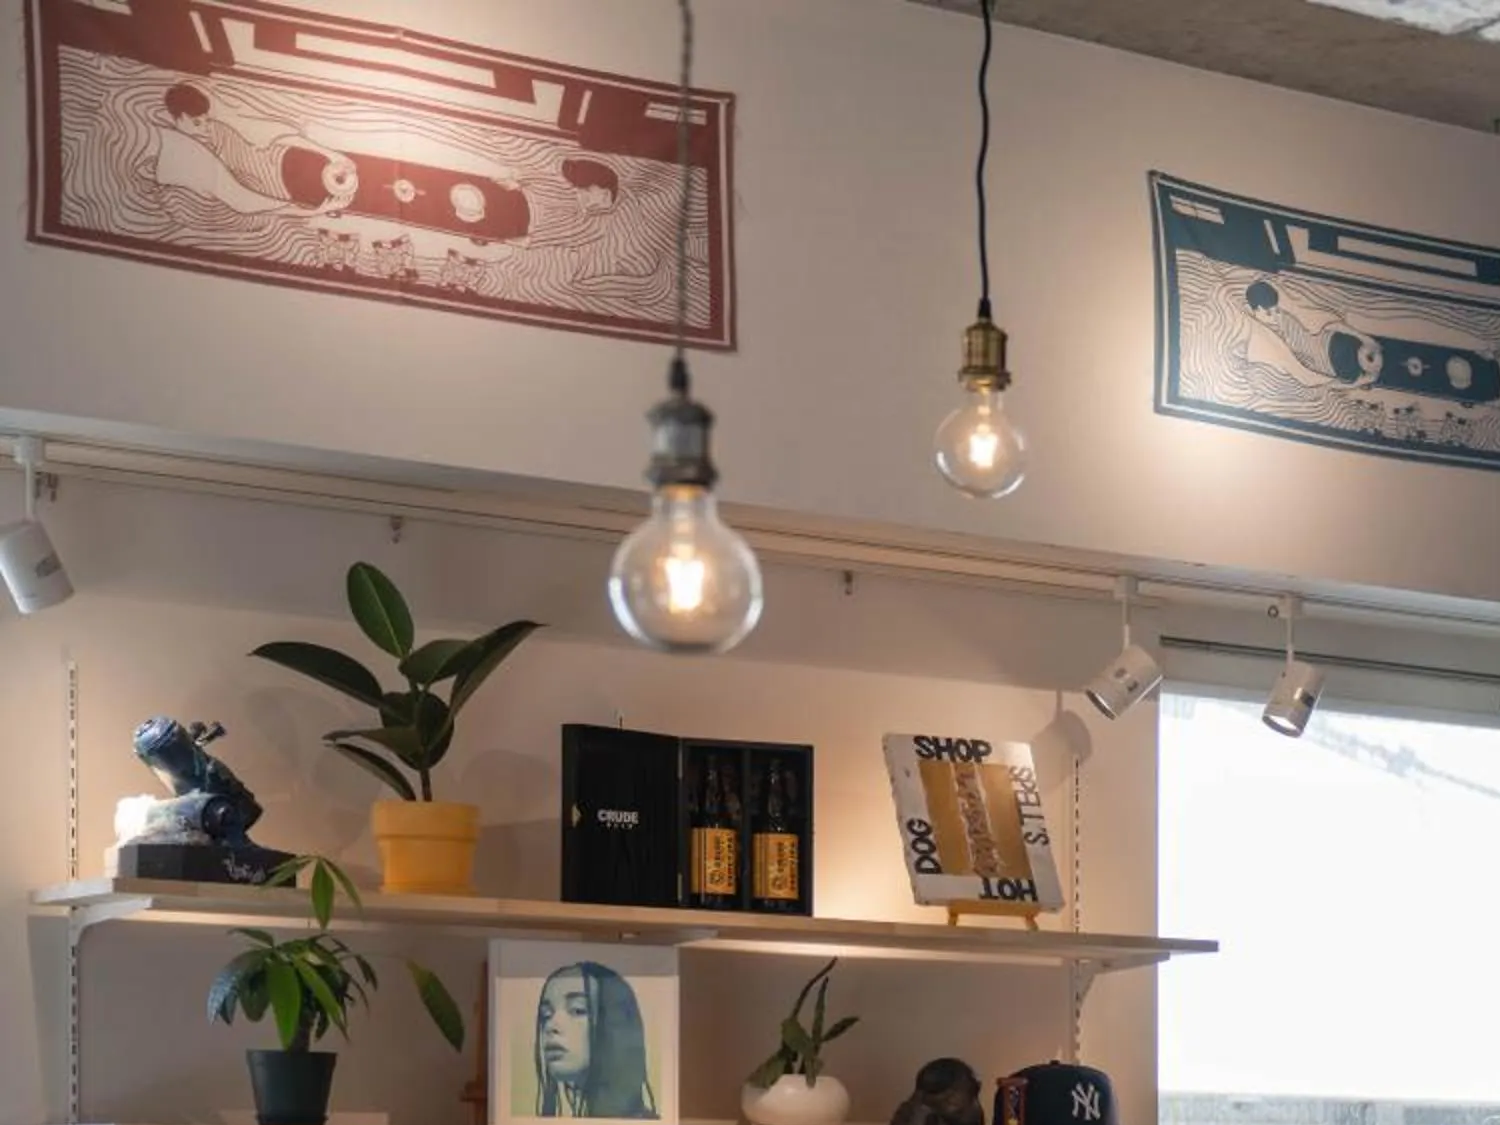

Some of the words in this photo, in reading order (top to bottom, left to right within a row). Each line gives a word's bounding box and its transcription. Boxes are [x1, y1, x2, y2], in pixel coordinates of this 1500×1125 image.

[913, 735, 992, 763] SHOP
[597, 809, 639, 824] CRUDE
[907, 818, 943, 874] DOG
[979, 876, 1039, 902] HOT
[1071, 1082, 1100, 1120] NY
